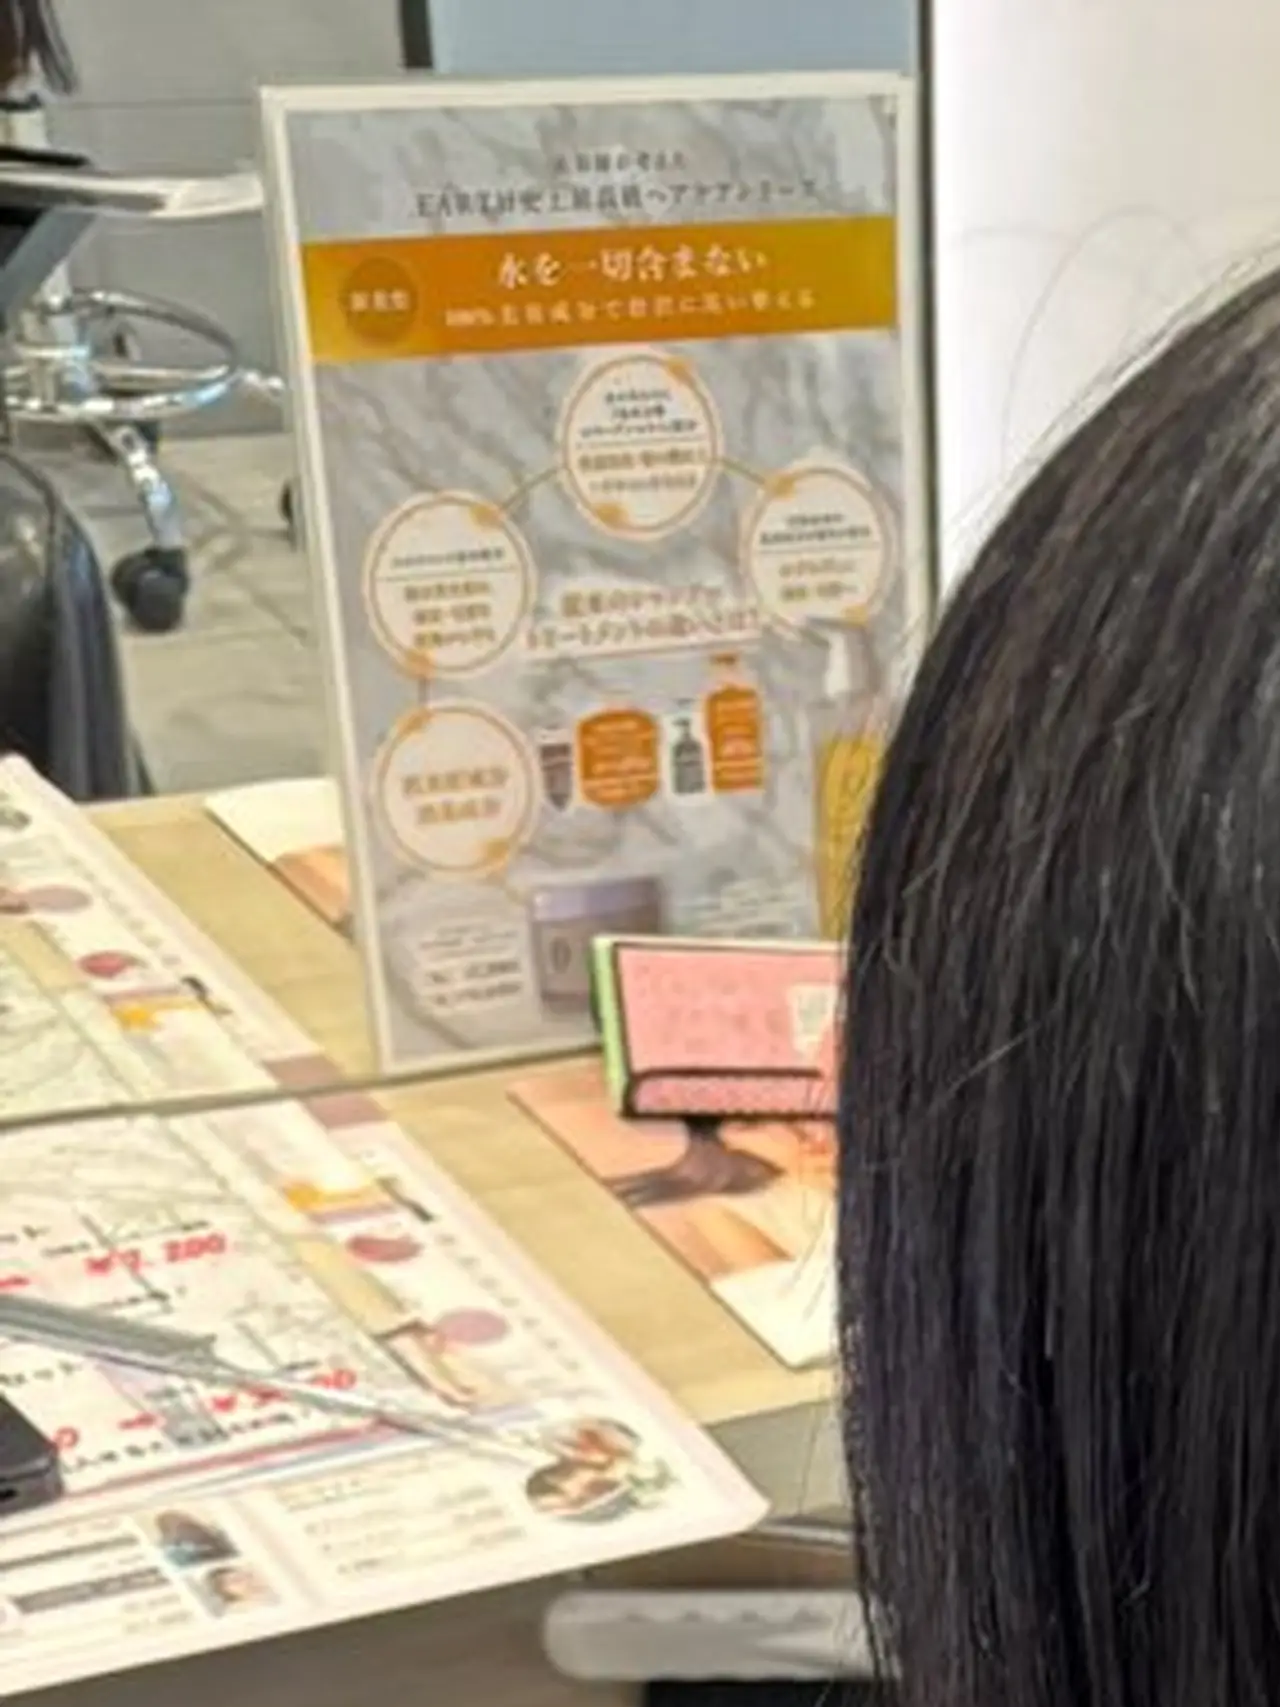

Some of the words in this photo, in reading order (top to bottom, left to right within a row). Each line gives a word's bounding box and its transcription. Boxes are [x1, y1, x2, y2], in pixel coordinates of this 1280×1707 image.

[499, 243, 768, 291] 水を一切含まない
